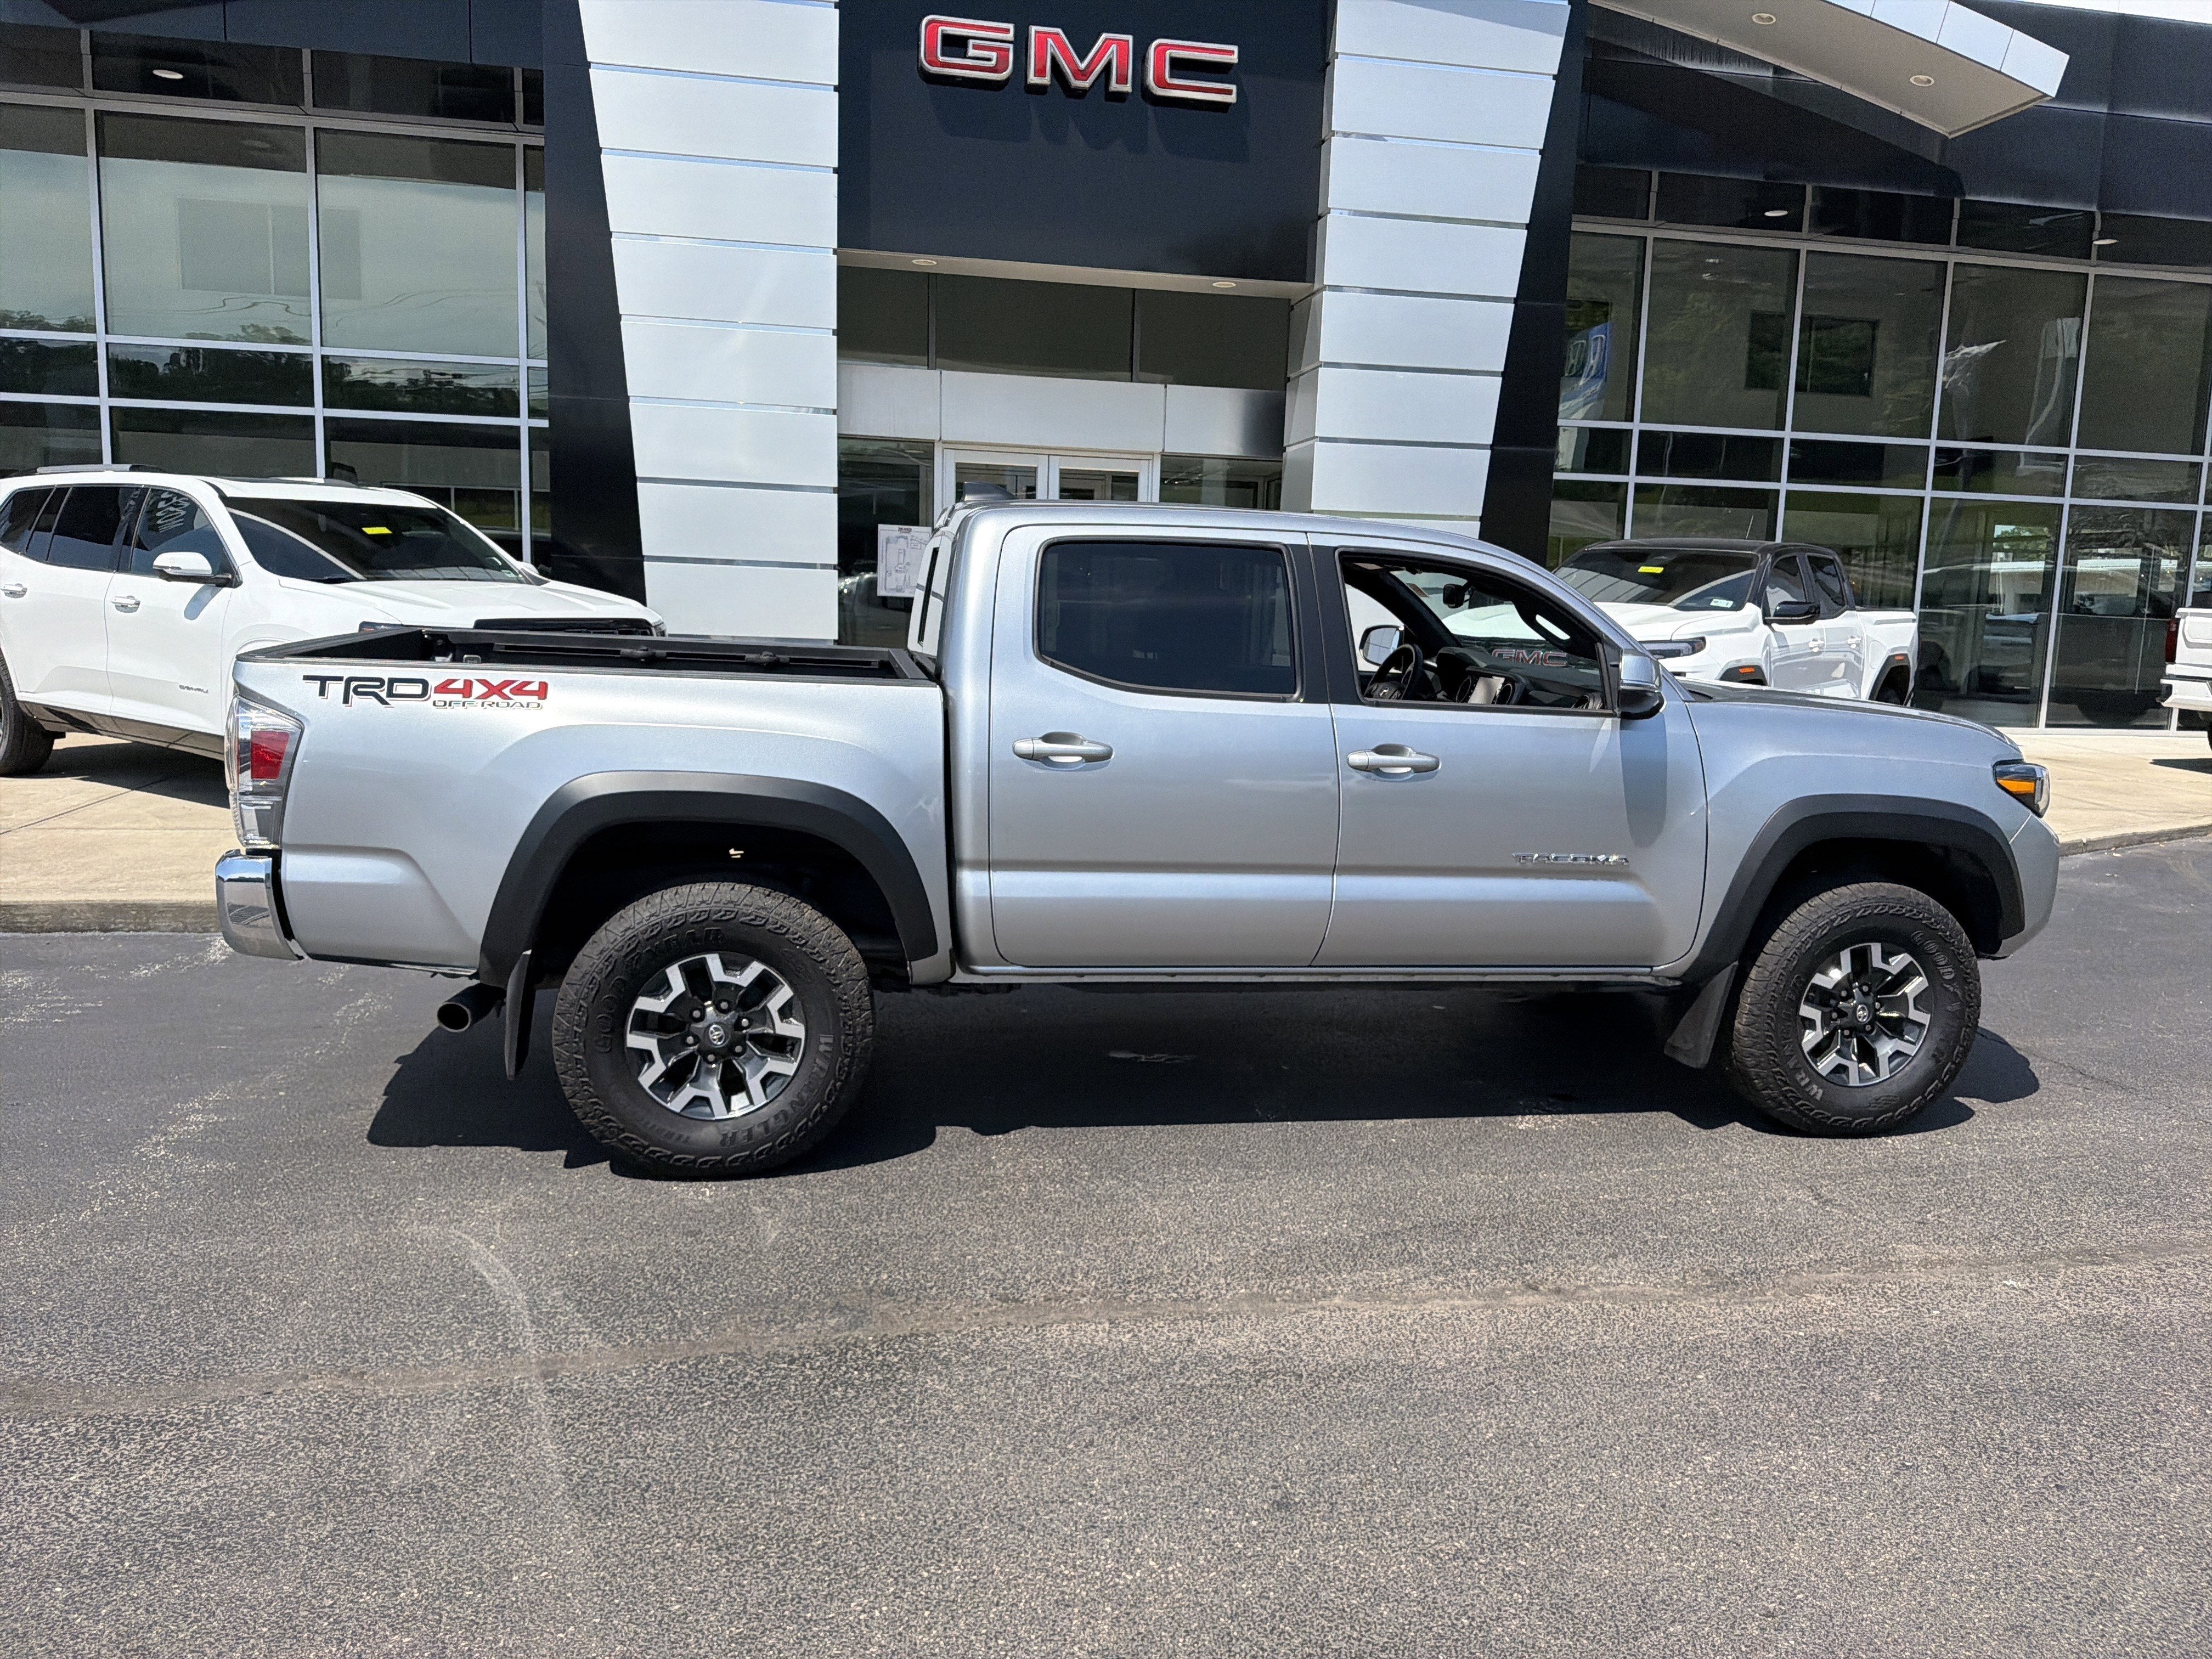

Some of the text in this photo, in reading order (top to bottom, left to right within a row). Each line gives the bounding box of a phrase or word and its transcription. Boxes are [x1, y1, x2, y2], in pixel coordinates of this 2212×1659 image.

[919, 14, 1239, 104] GMC
[1492, 649, 1568, 667] GMC
[302, 675, 431, 708] TRD
[432, 700, 543, 710] OFF ROAD
[1512, 853, 1629, 866] TACOMA
[719, 1034, 834, 1147] WRANGLER
